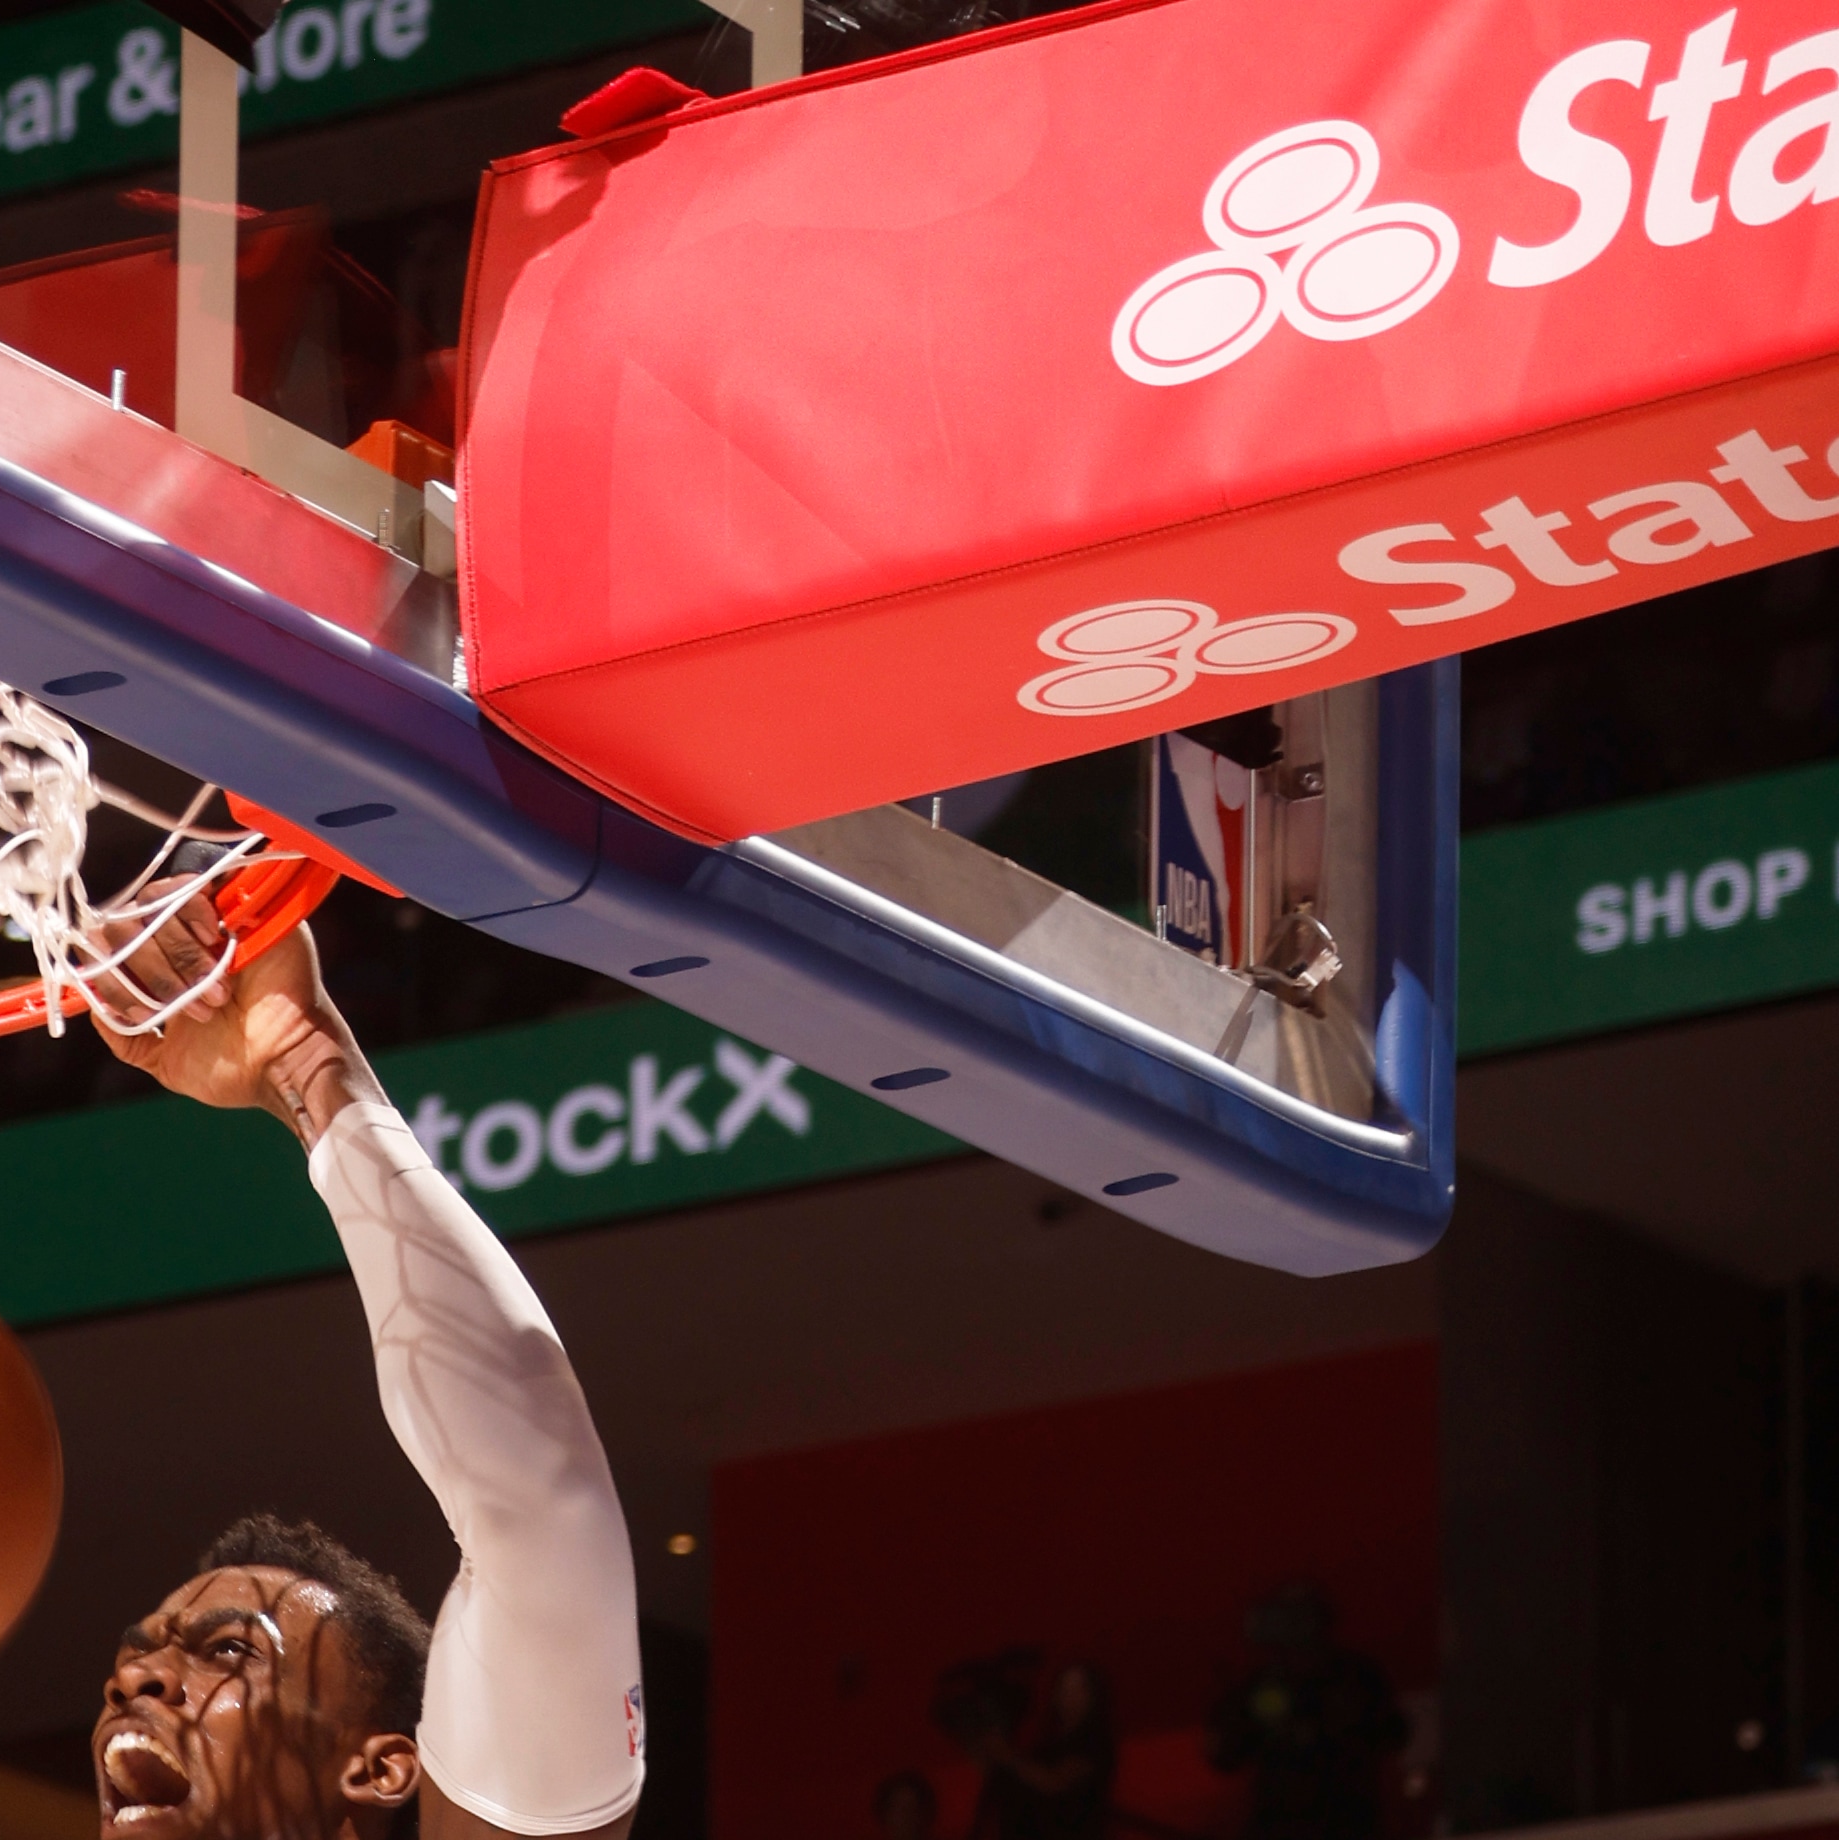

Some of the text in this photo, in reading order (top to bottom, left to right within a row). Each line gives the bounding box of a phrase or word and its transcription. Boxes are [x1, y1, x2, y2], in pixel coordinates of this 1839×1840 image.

[106, 26, 181, 128] &
[236, 0, 433, 98] ore
[1338, 429, 1839, 627] Stat
[1164, 861, 1213, 945] NBA
[1576, 848, 1812, 955] SHOP
[410, 1038, 812, 1192] tockX
